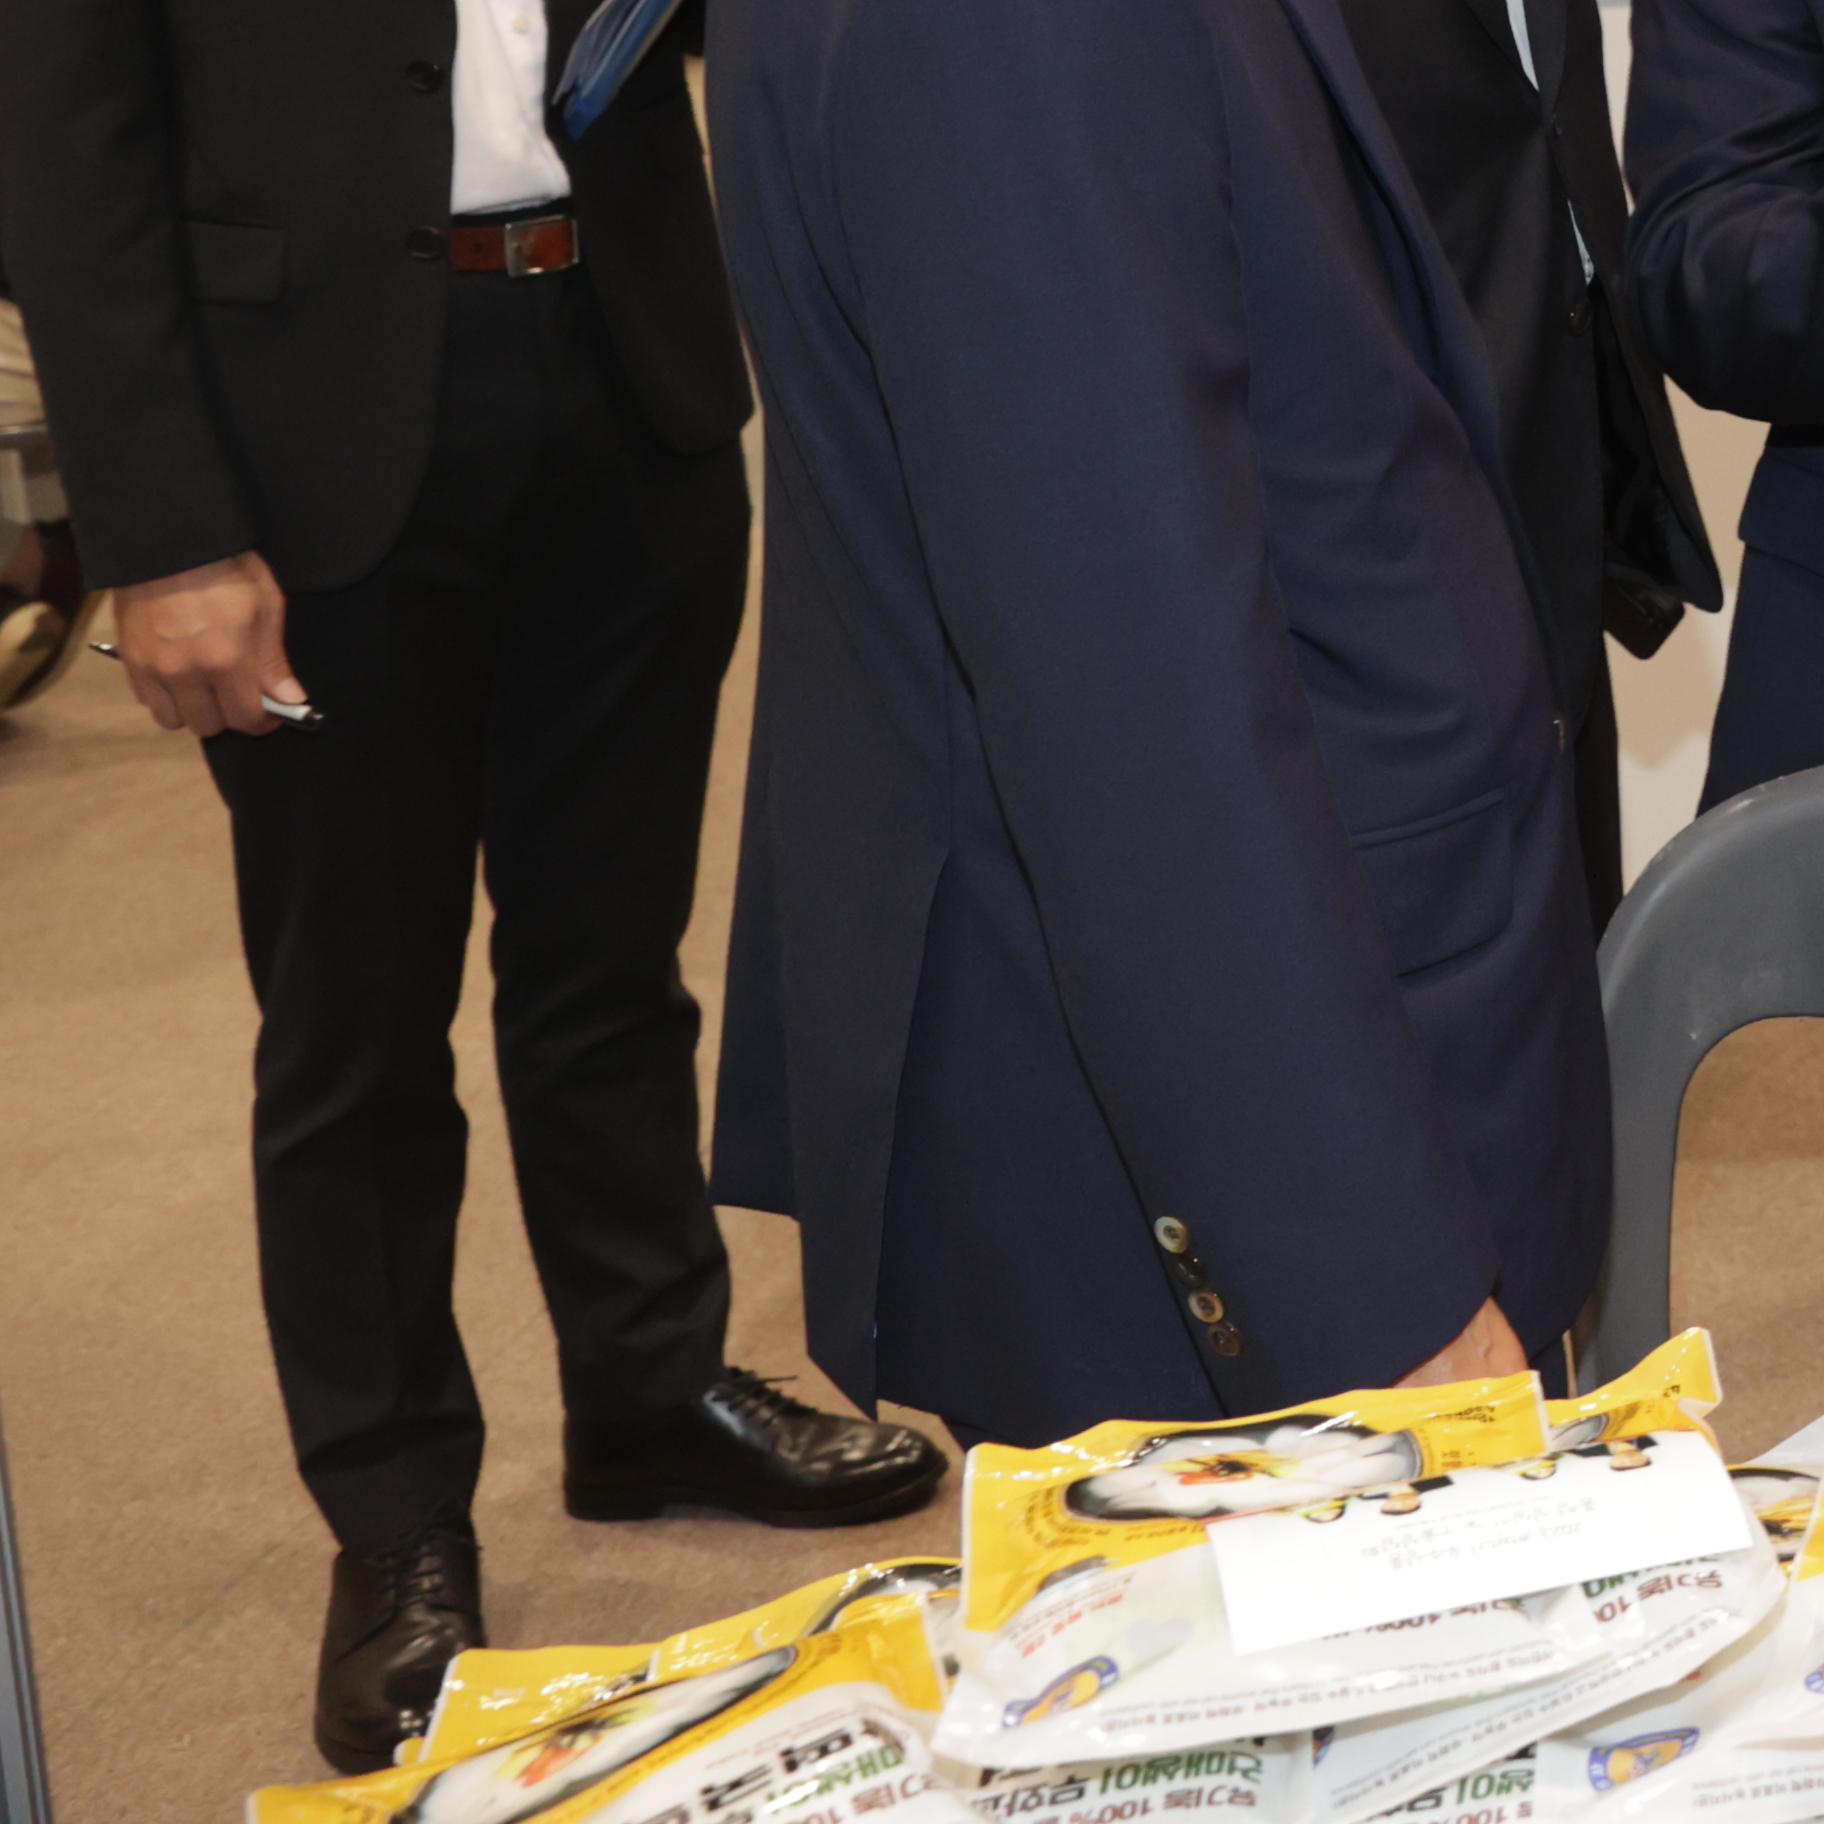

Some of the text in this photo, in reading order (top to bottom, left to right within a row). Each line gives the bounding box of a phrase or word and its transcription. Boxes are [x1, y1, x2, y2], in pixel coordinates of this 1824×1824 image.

[1636, 1570, 1722, 1602] 유기농
[1099, 1750, 1263, 1795] 건매생이
[1456, 1767, 1535, 1806] 생이
[1162, 1784, 1257, 1811] 유기농
